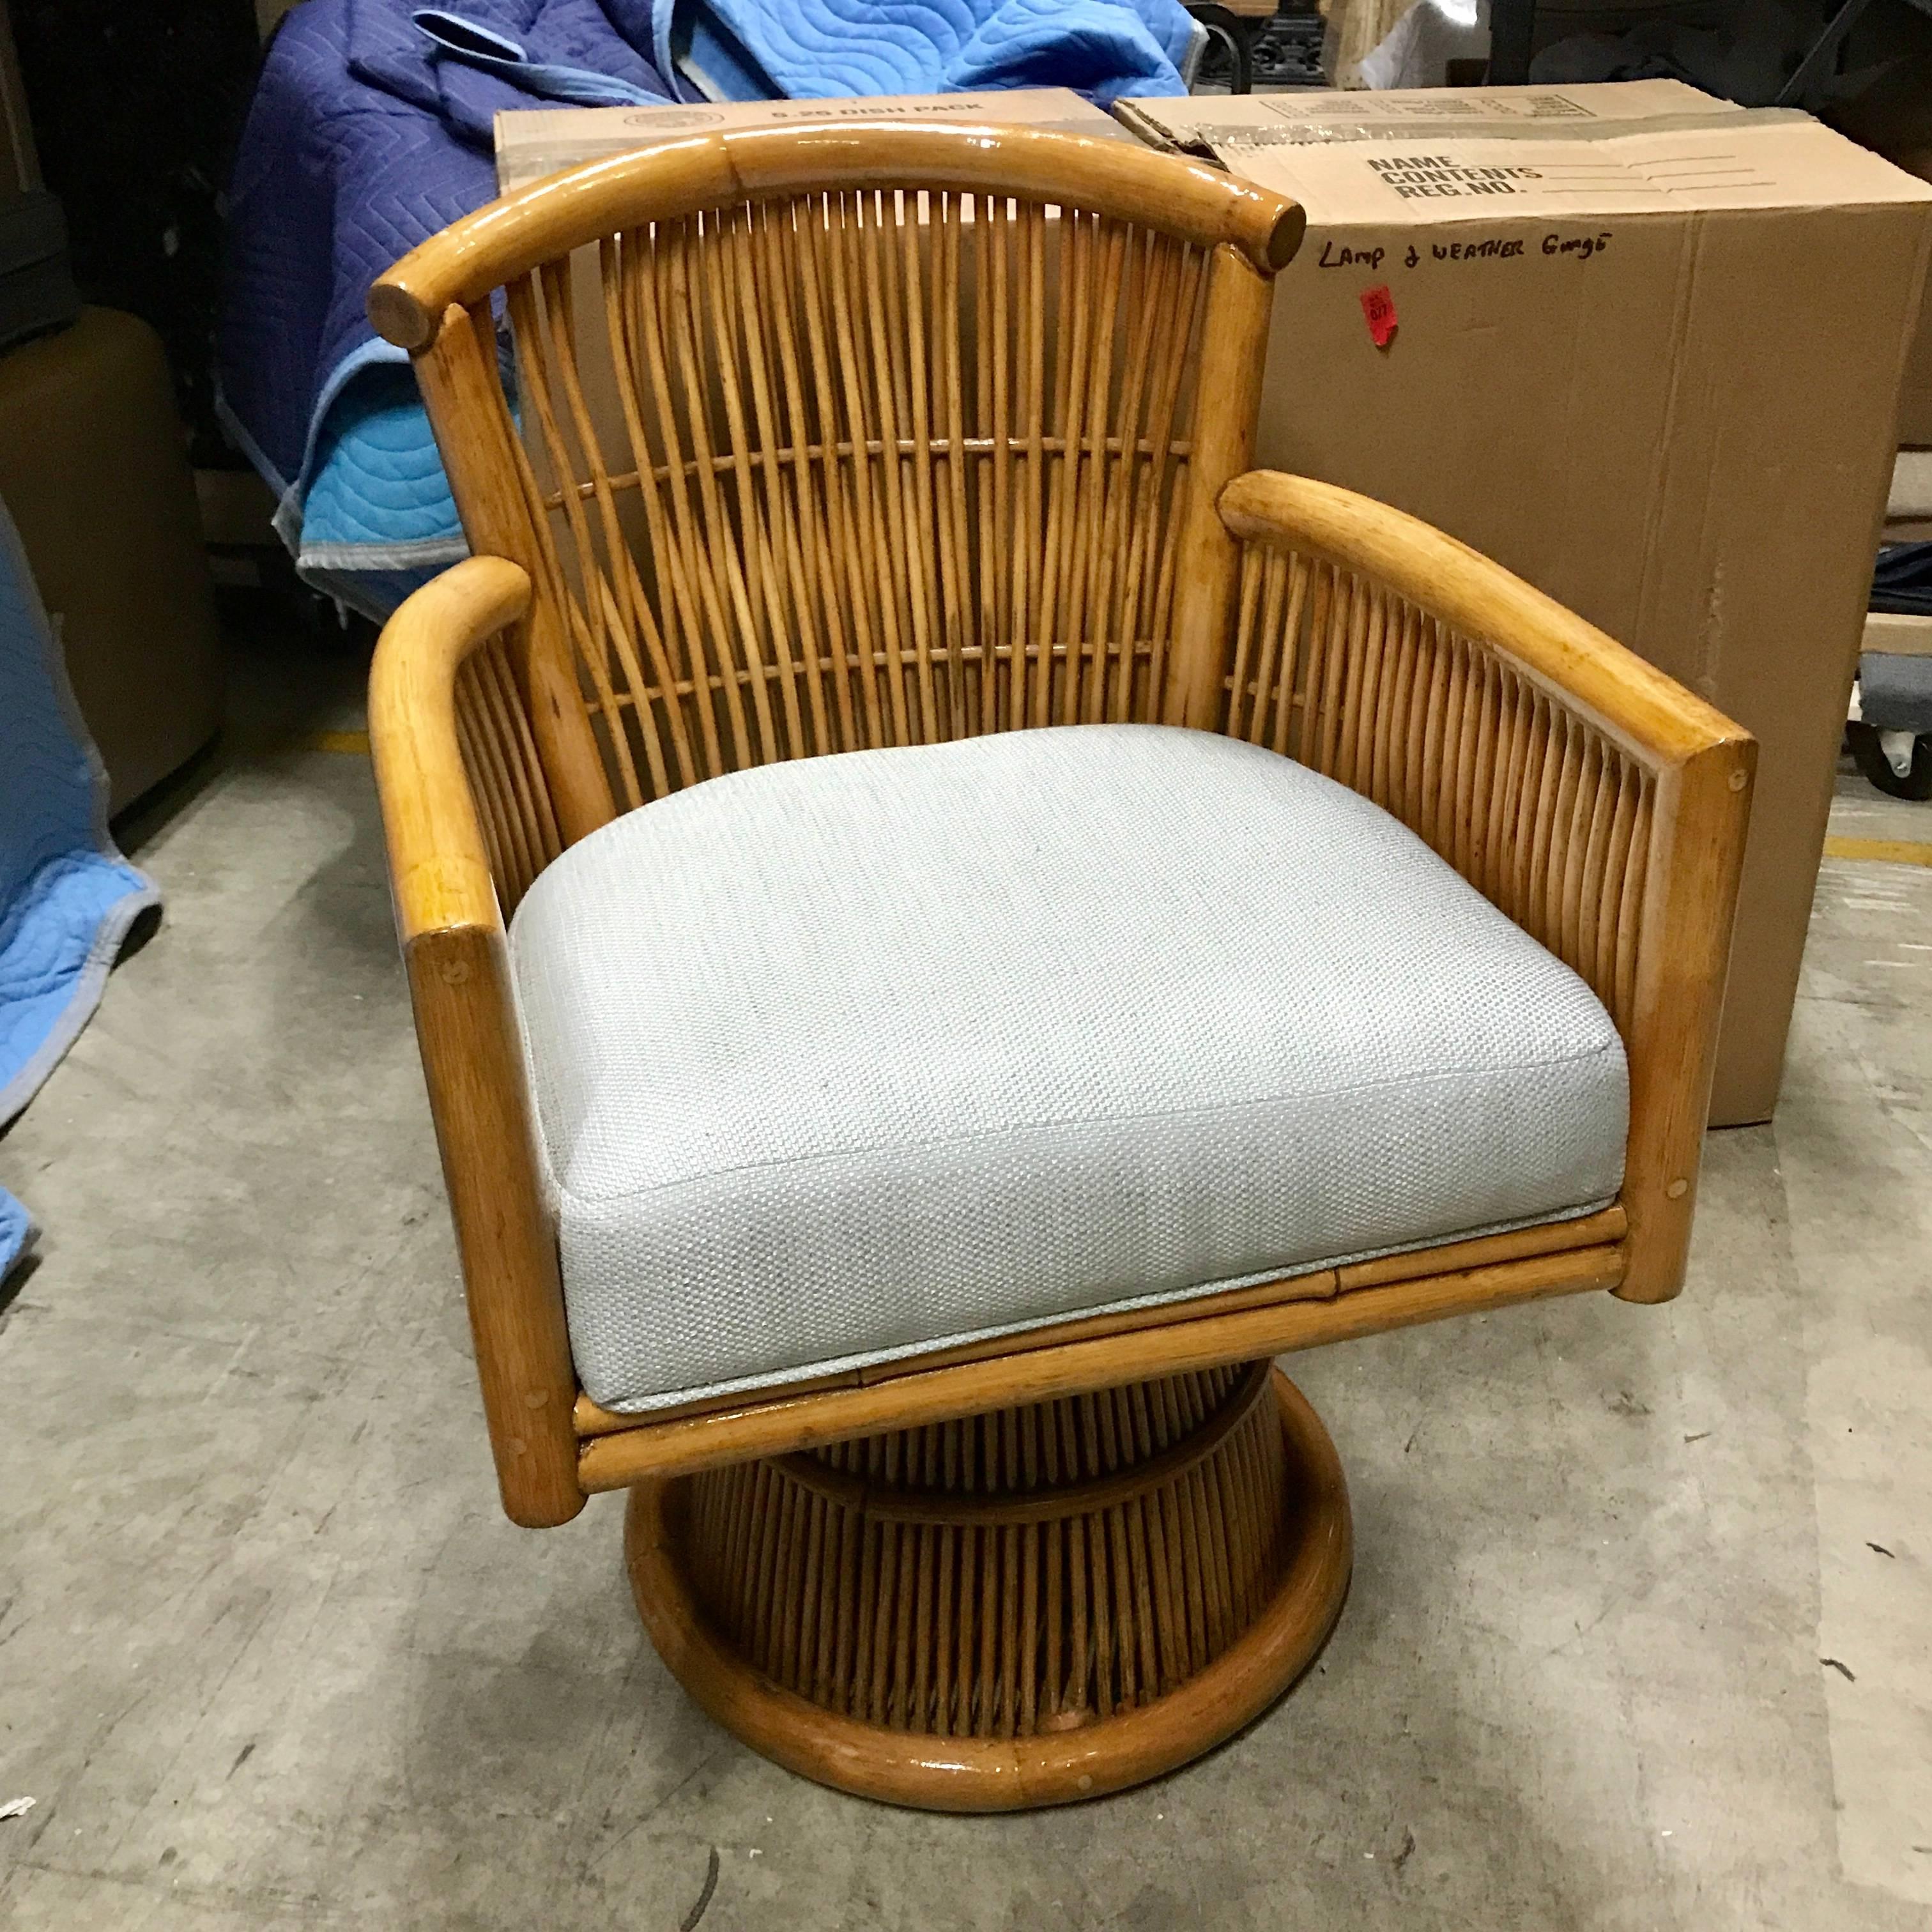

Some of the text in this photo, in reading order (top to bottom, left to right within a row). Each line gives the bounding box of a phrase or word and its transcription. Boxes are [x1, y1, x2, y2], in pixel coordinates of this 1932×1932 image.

[913, 103, 984, 112] PACK
[1367, 156, 1461, 171] NAME
[1381, 167, 1544, 185] CONTENTS
[1432, 240, 1525, 260] WEATHER
